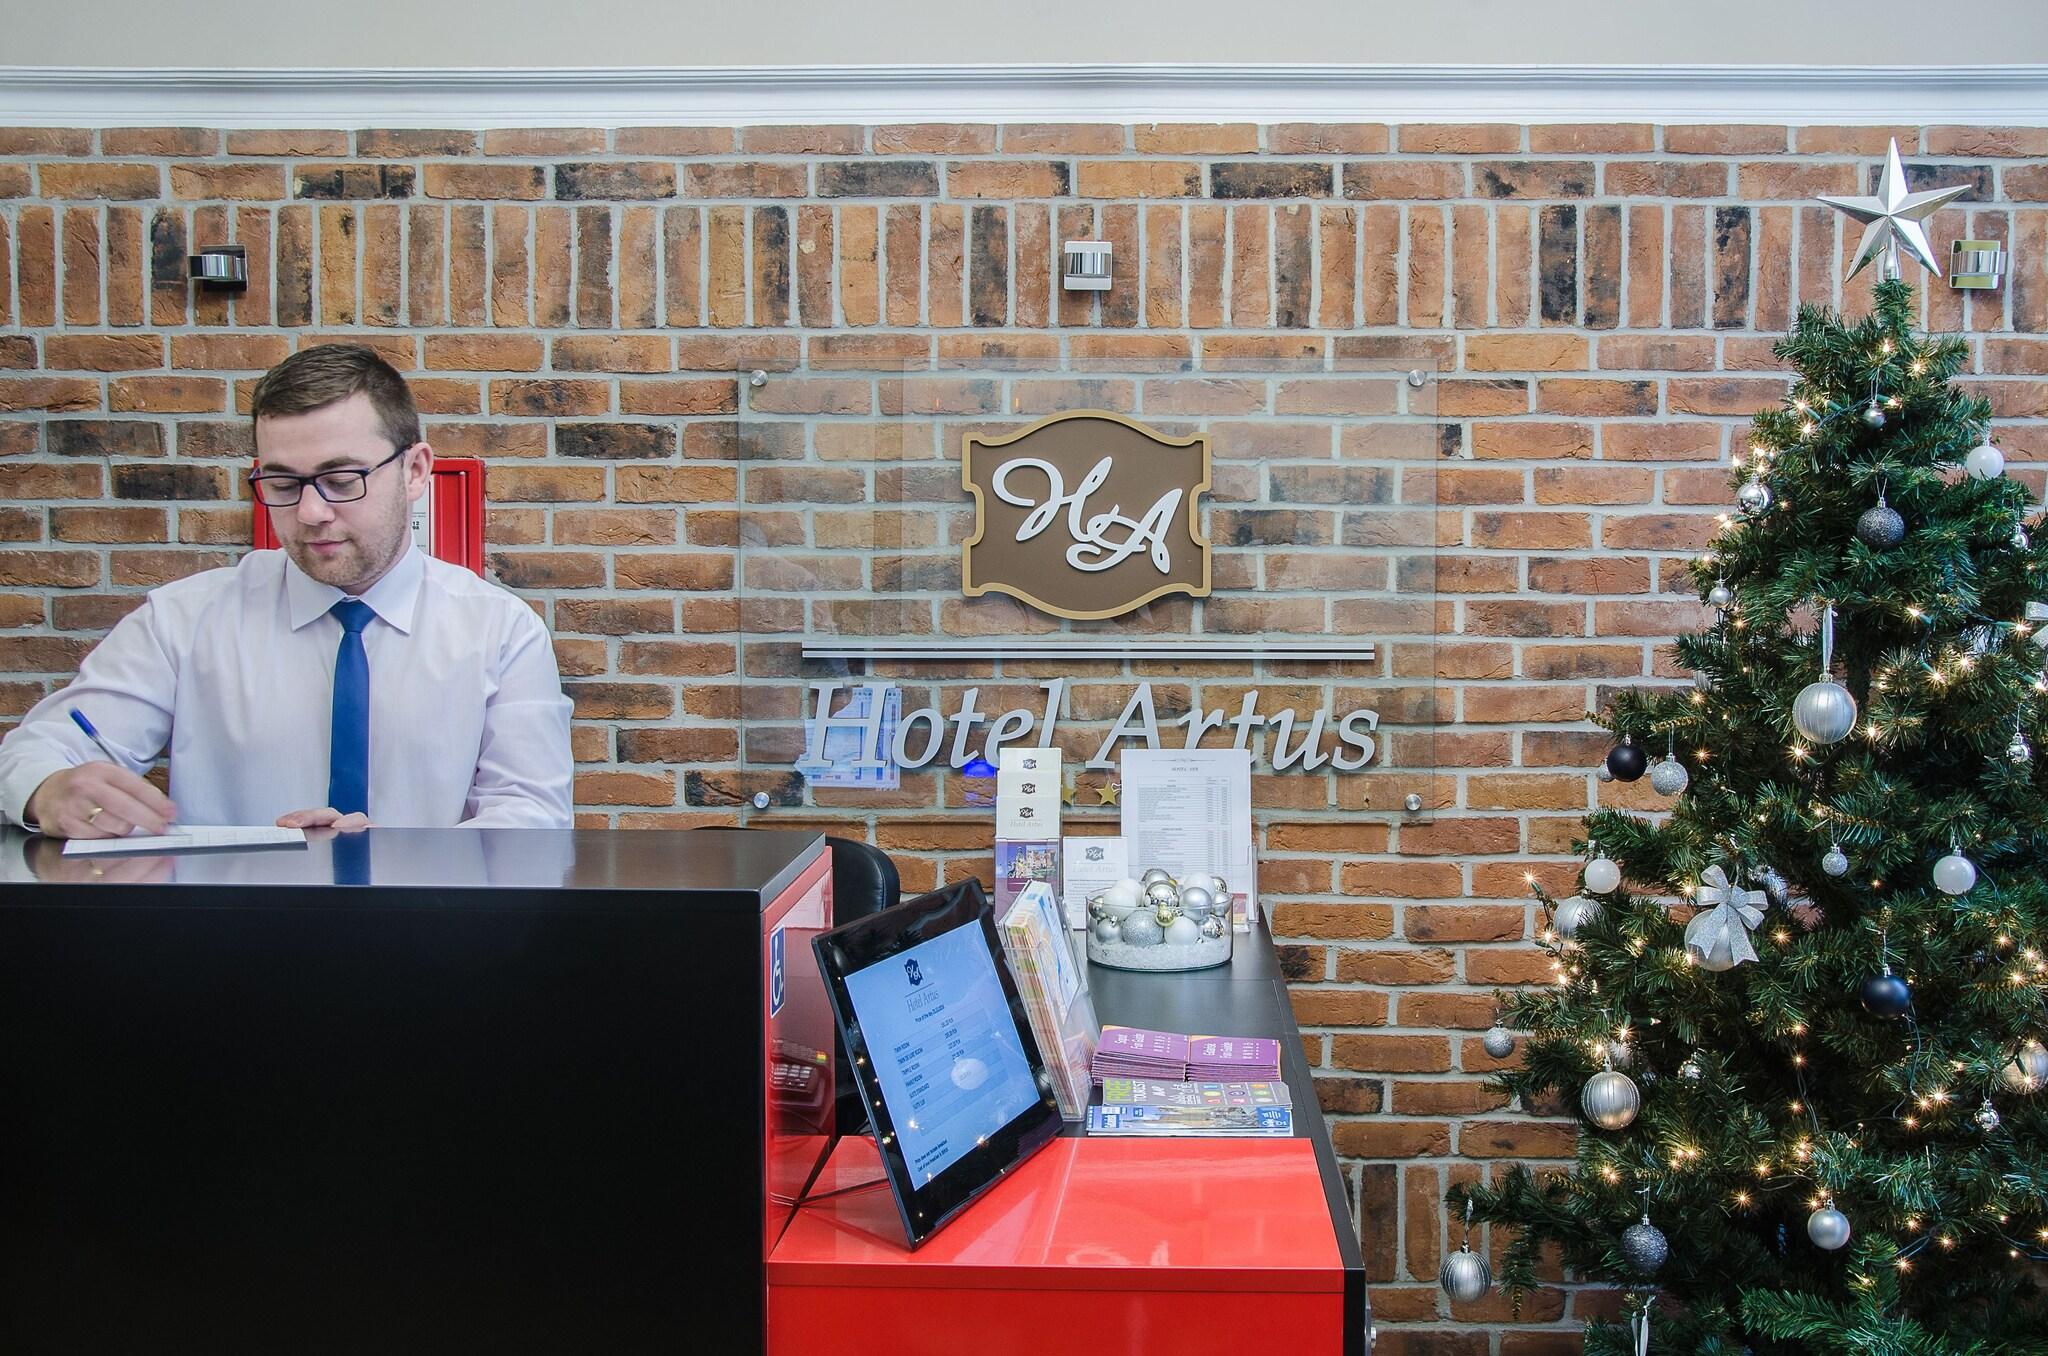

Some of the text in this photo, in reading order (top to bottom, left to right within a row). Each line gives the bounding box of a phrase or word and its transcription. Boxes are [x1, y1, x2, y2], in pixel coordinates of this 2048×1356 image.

[799, 678, 1378, 772] Hotel Artus
[1106, 1079, 1132, 1101] FREE
[1132, 1080, 1147, 1102] TOURIST
